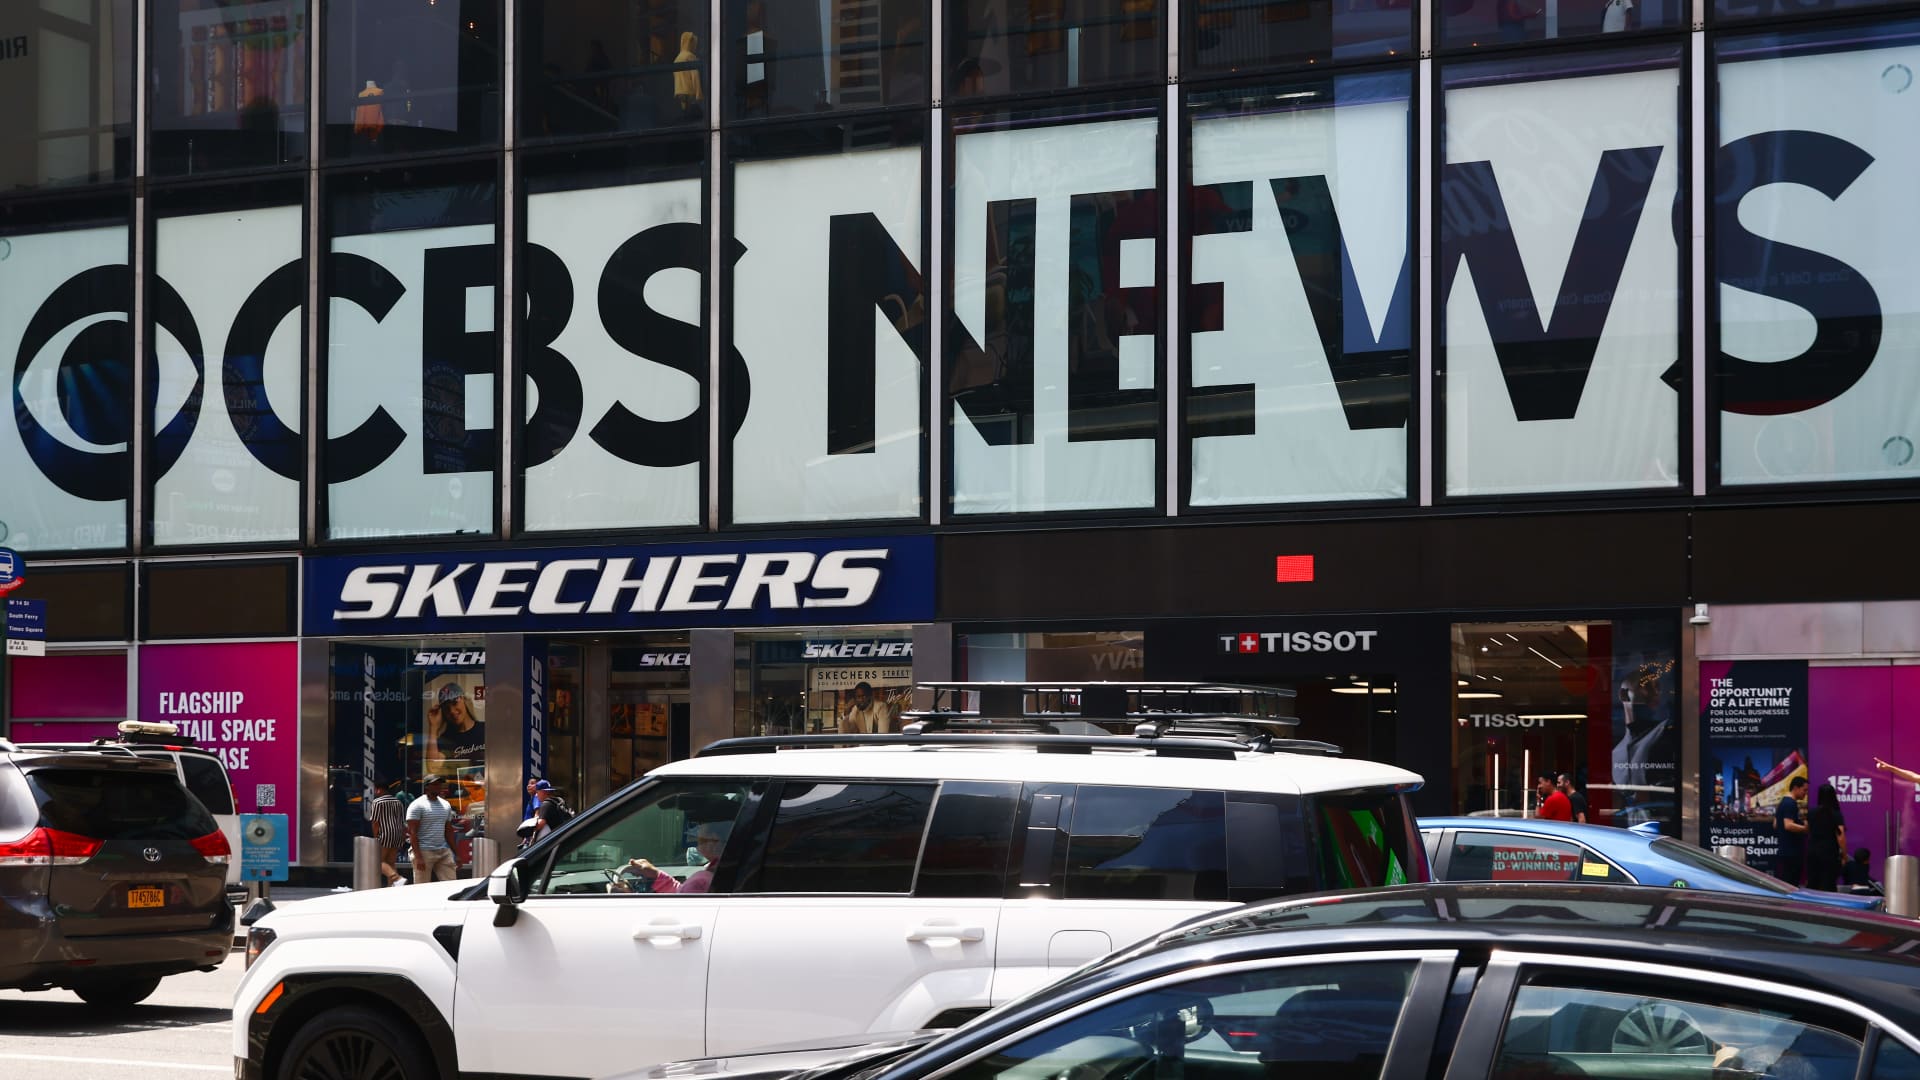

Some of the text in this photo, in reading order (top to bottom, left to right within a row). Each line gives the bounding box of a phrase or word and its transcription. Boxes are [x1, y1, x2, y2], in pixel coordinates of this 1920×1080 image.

[222, 130, 1883, 485] CBS NEWS
[333, 549, 889, 620] SKECHERS
[1260, 630, 1378, 653] TISSOT
[817, 669, 910, 680] SKECHERS STREET
[1710, 678, 1733, 688] THE
[1710, 687, 1792, 698] OPPORTUNITY
[160, 691, 244, 714] FLAGSHIP
[1710, 697, 1790, 707] OF A LIFETIME
[1470, 713, 1545, 728] TISSOT
[221, 719, 276, 742] SPACE
[1614, 761, 1638, 769] FOCUS
[1724, 826, 1753, 836] Support
[1711, 836, 1756, 845] Caesars
